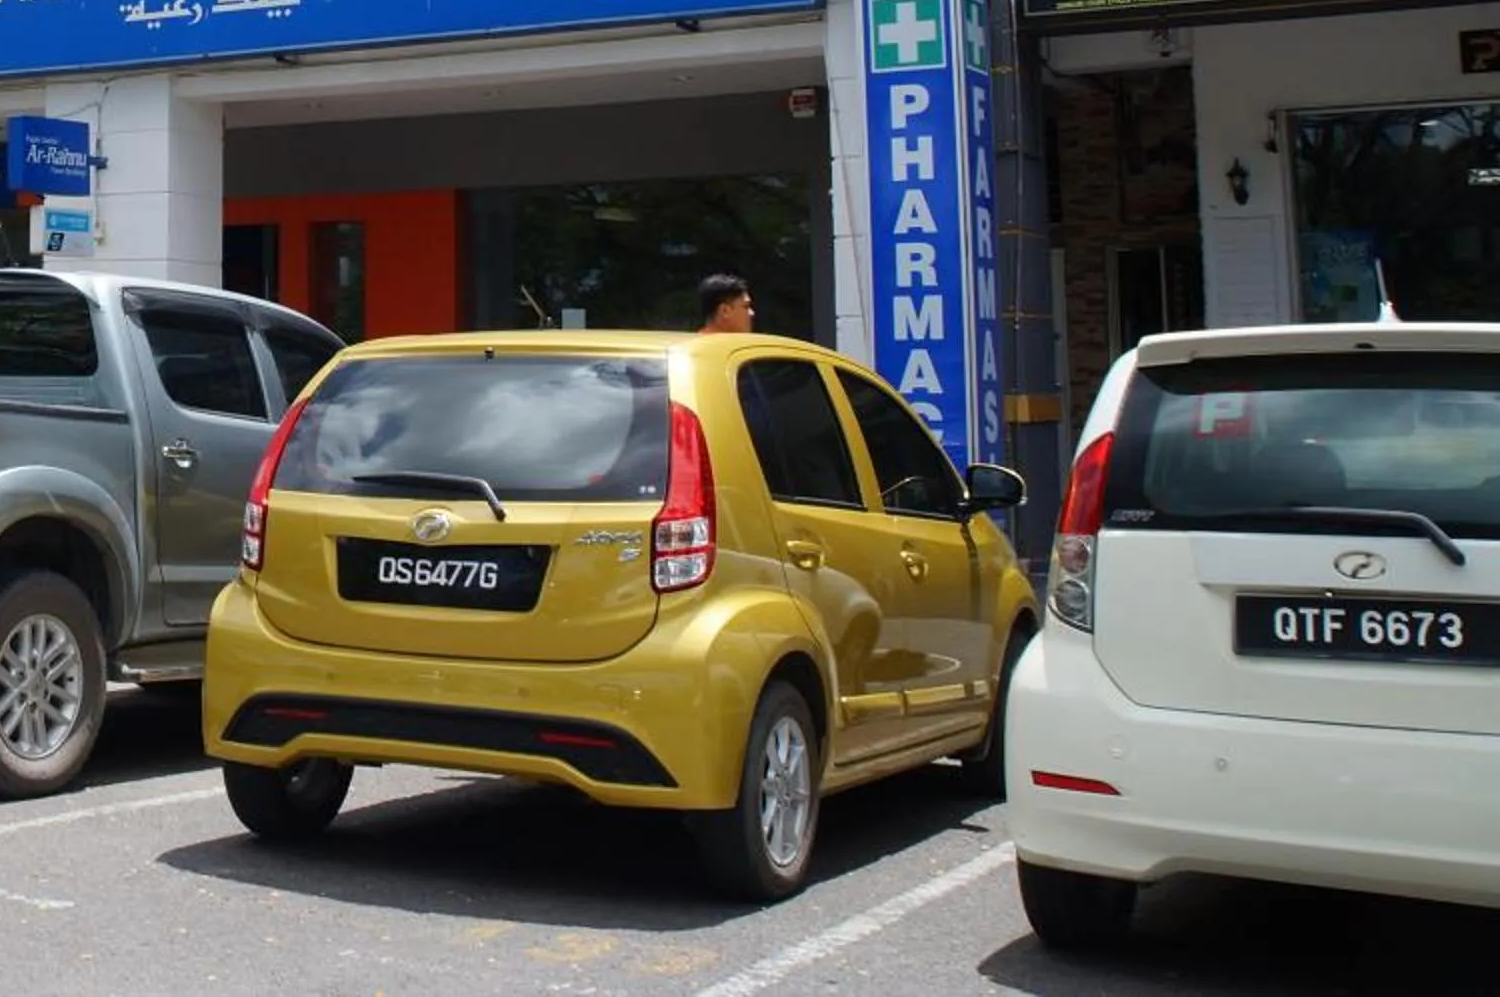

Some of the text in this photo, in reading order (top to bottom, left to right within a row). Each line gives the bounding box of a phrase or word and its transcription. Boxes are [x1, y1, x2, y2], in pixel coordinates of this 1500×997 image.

[972, 86, 1000, 463] FARMAS
[1200, 392, 1245, 433] P
[379, 556, 499, 589] QS6477G
[1273, 606, 1464, 648] QTF 6673
